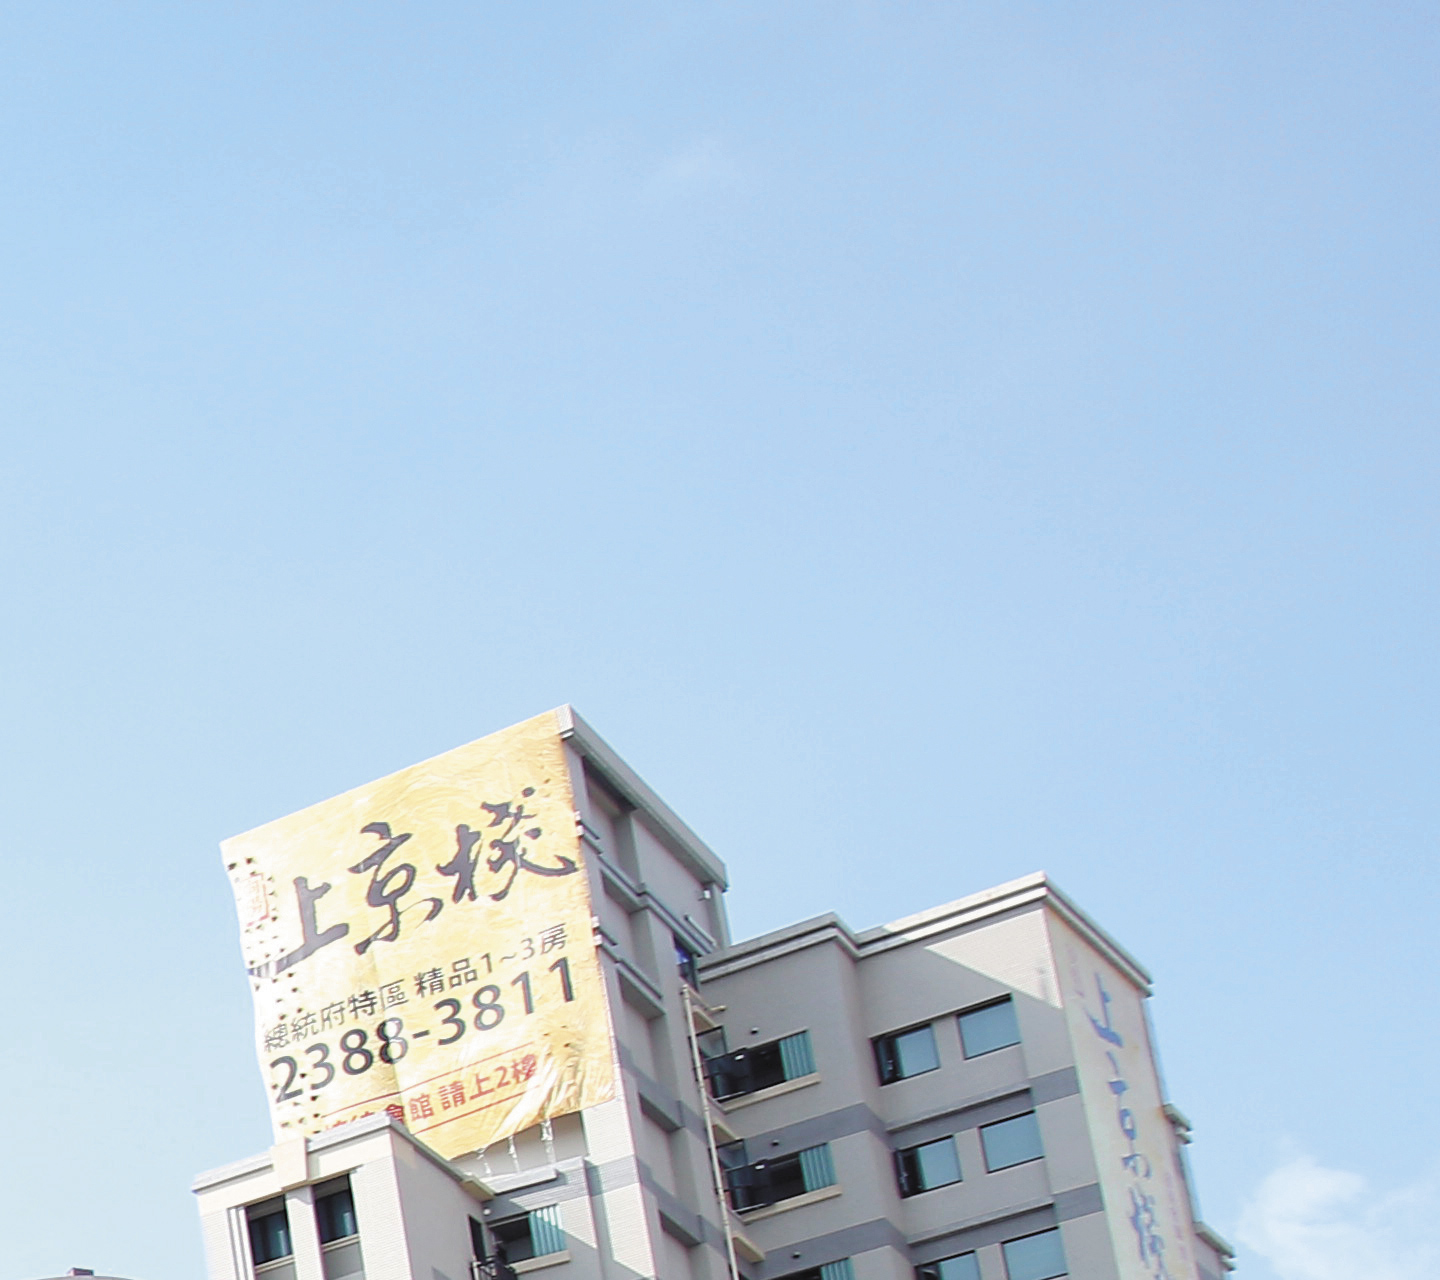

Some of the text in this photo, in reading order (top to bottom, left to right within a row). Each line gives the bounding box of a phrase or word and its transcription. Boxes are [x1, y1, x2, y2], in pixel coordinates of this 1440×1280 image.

[264, 977, 410, 1052] 總統府特區
[269, 956, 576, 1103] 2388-3811
[324, 1053, 538, 1130] 會館 請上2樓
